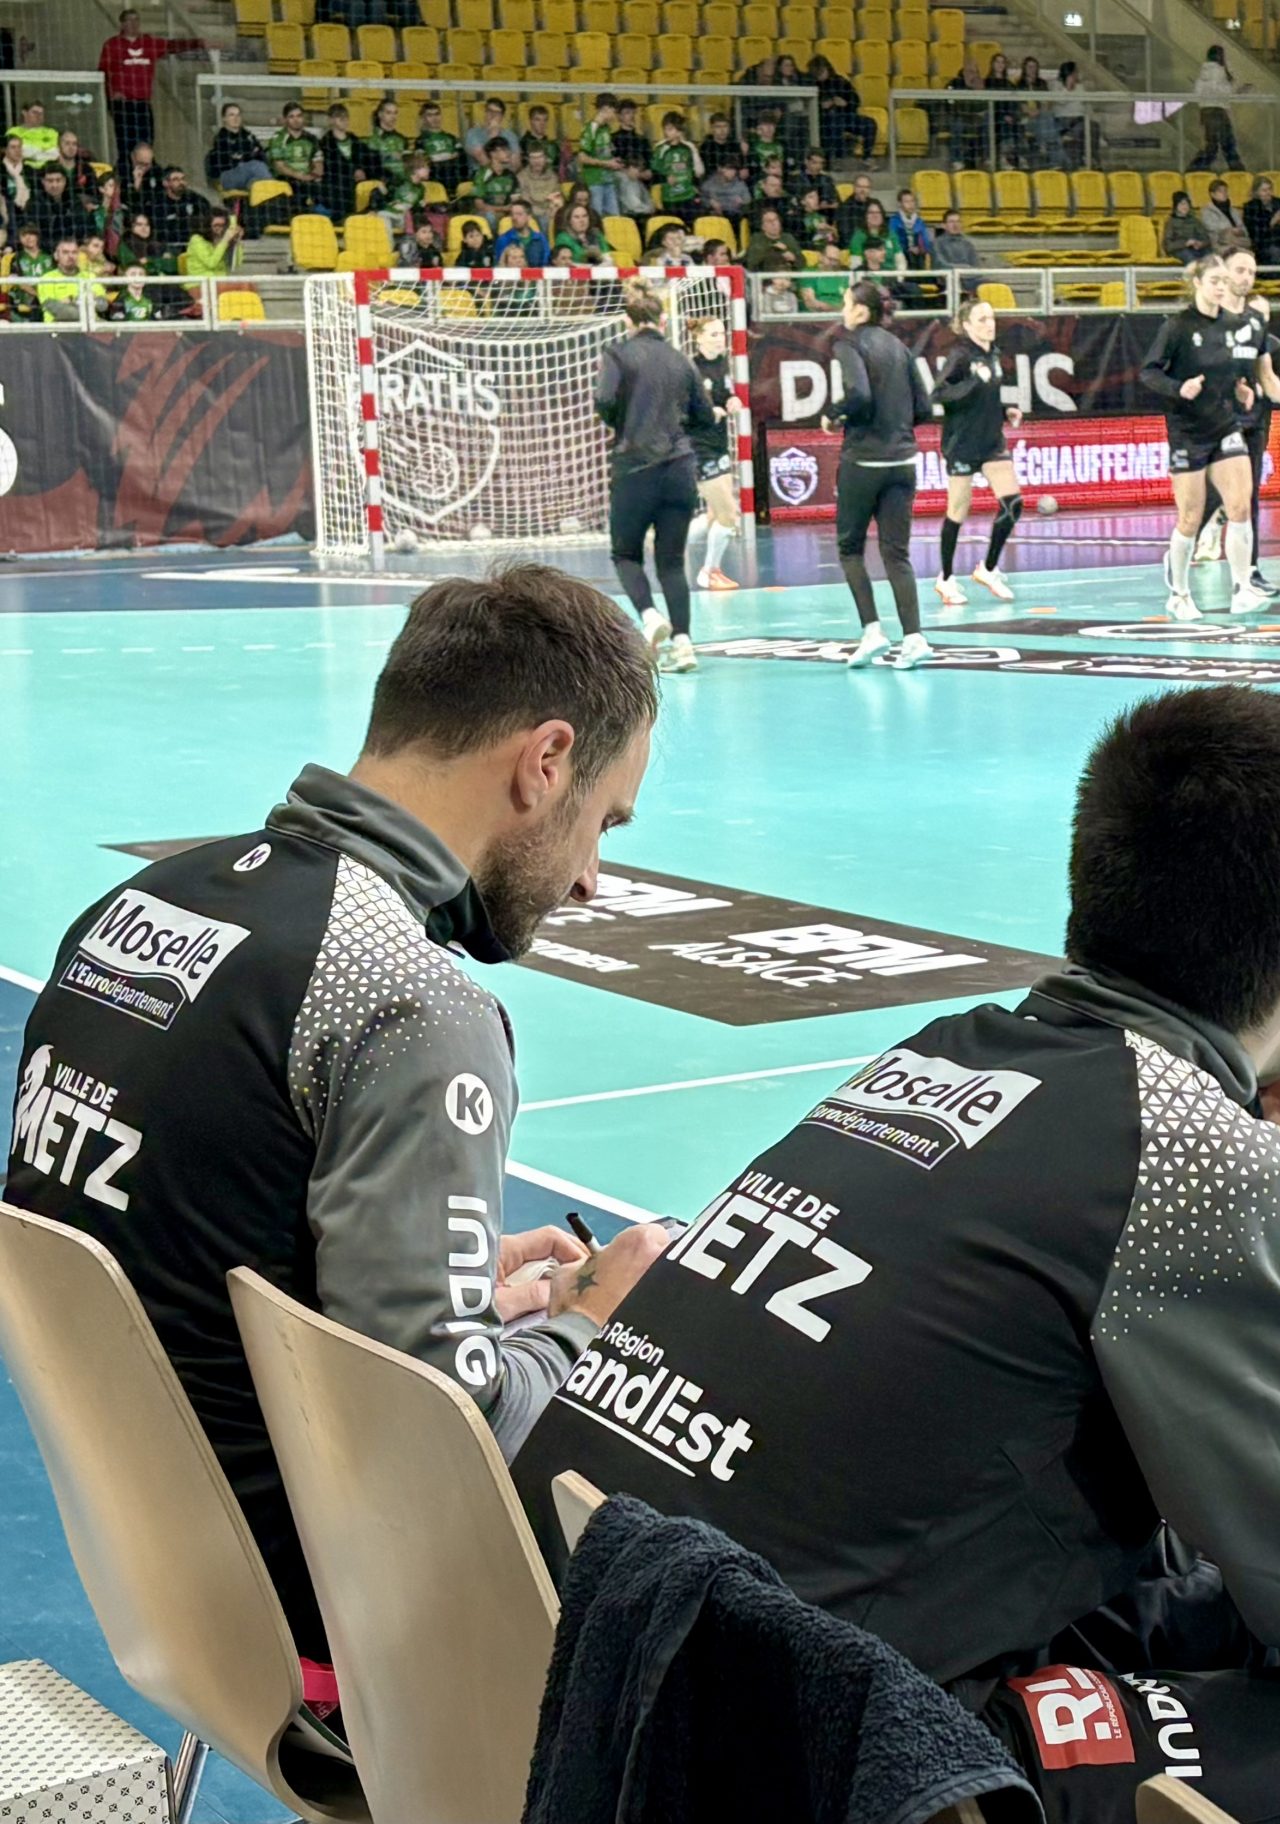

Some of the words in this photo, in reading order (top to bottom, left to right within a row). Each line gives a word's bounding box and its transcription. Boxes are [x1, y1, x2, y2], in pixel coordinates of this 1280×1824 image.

[347, 372, 500, 421] RATHS
[1012, 439, 1170, 486] ÉCHAUFFEME
[89, 898, 219, 980] Moselle
[647, 941, 863, 988] ALSACE
[727, 923, 989, 977] BFM
[66, 961, 174, 1020] L'Eurodépartement
[53, 1063, 94, 1100] VILLE
[89, 1081, 118, 1112] DE
[11, 1085, 143, 1212] METZ
[737, 1171, 802, 1210] VILLE
[792, 1194, 841, 1230] DE
[448, 1195, 497, 1387] INDIG
[666, 1191, 873, 1342] ETZ
[604, 1322, 665, 1367] Région
